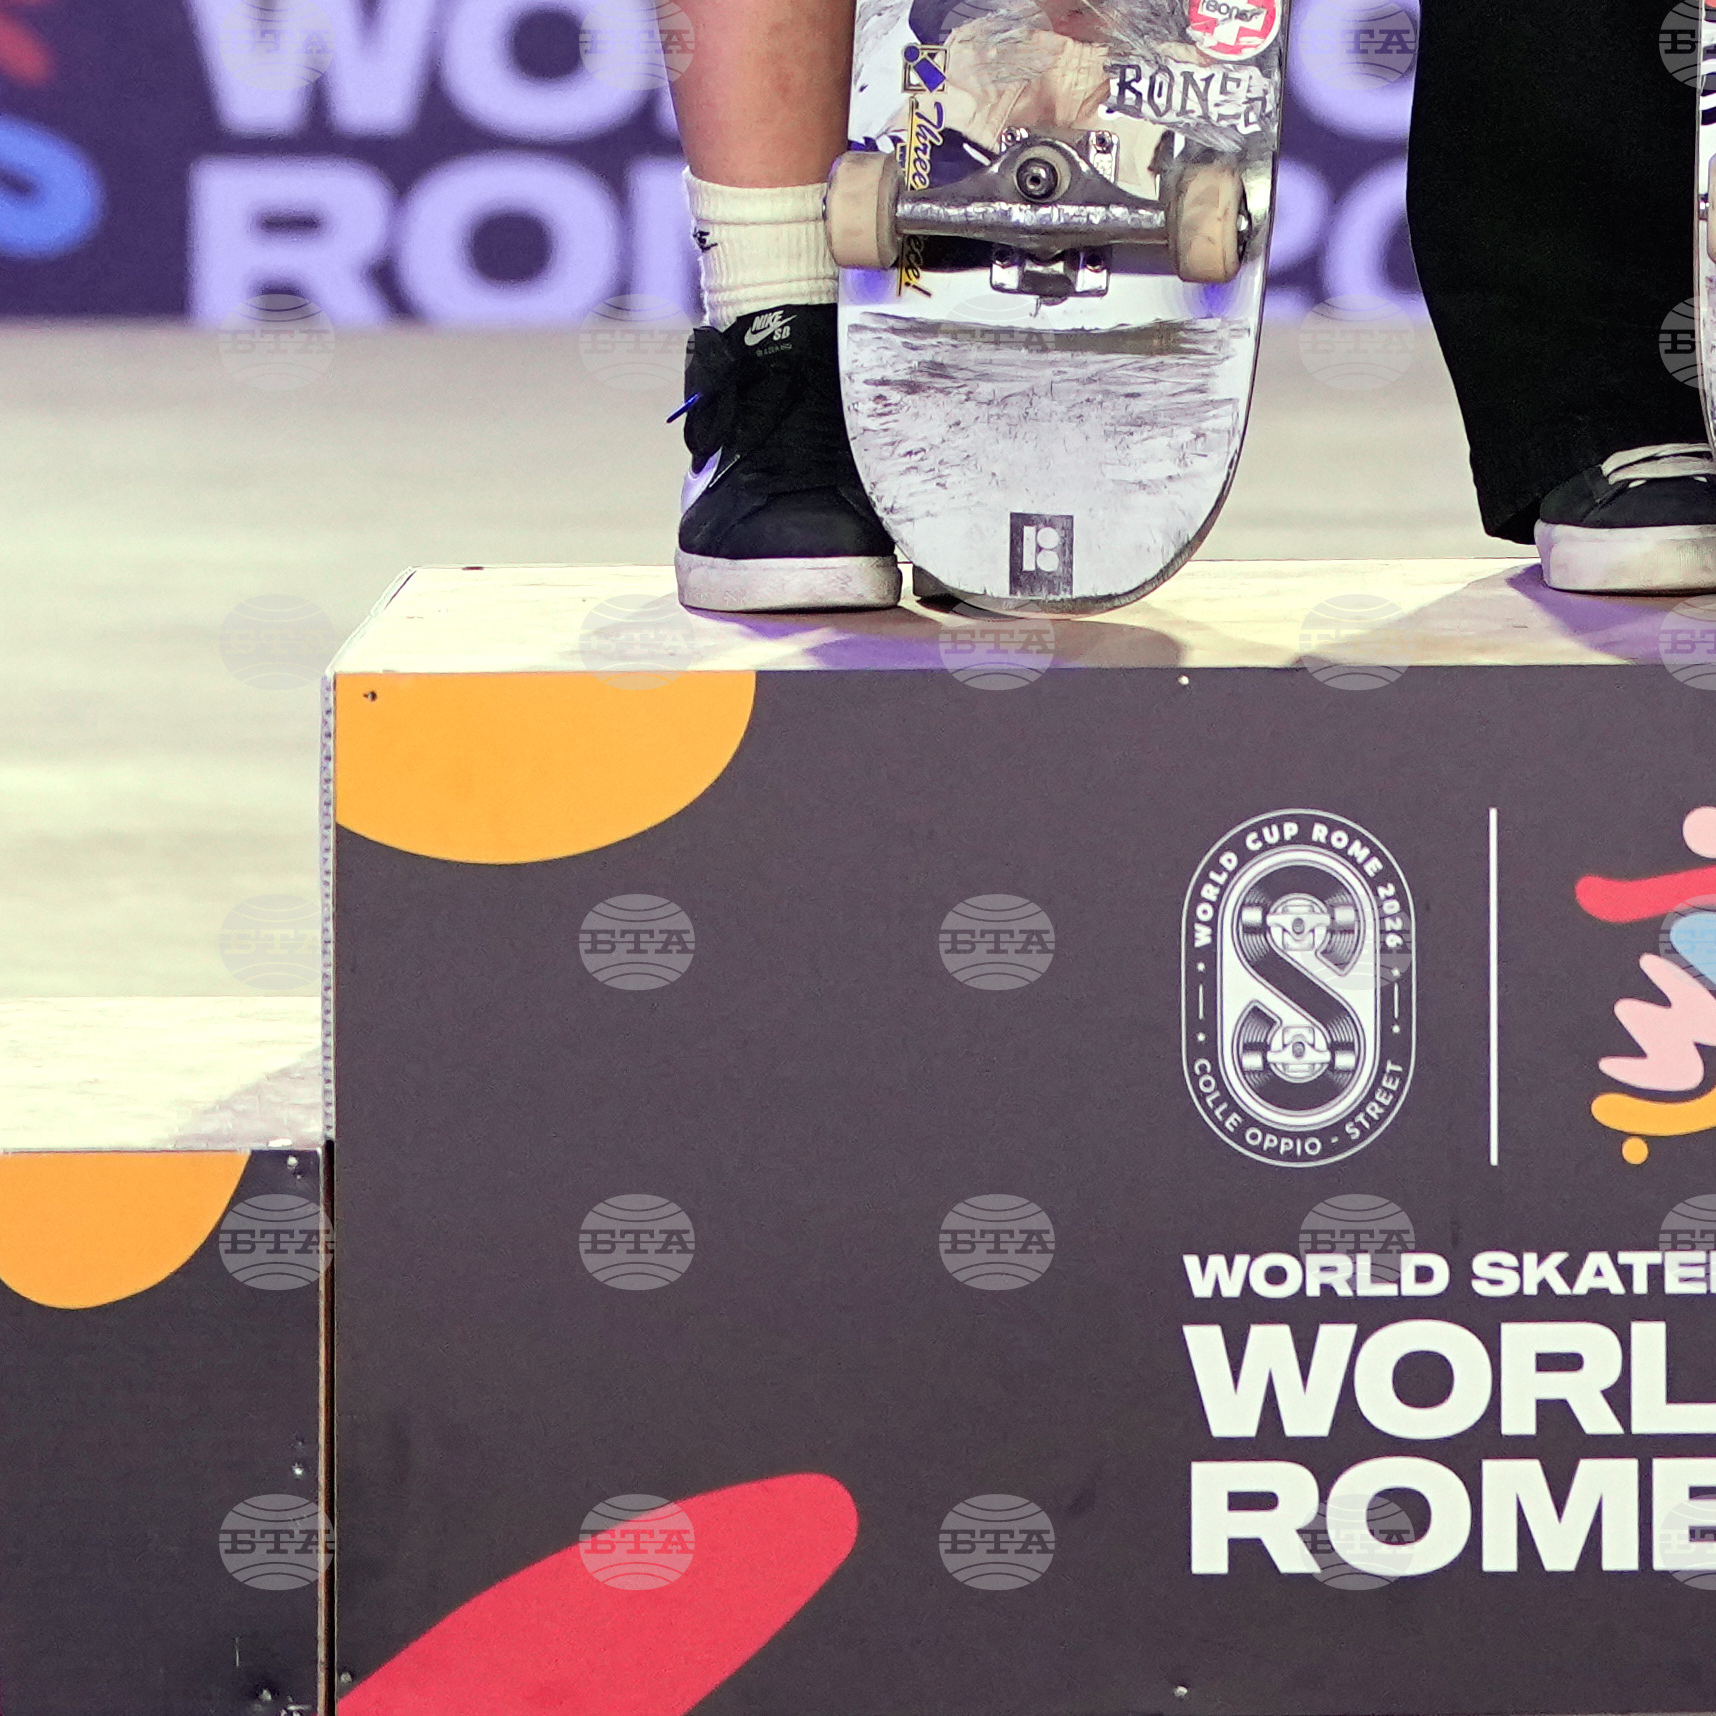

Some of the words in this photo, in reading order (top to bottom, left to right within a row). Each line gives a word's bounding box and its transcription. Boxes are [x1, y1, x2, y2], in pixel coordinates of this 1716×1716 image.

[911, 100, 946, 190] Three
[751, 310, 784, 332] NIKE
[1193, 851, 1239, 948] WORLD
[1245, 821, 1299, 851] CUP
[1311, 822, 1384, 878] ROME
[1377, 882, 1404, 949] 2026
[1194, 1058, 1243, 1133] COLLE
[1245, 1126, 1322, 1157] OPPIO
[1345, 1060, 1403, 1140] STREET
[1182, 1251, 1450, 1298] WORLD
